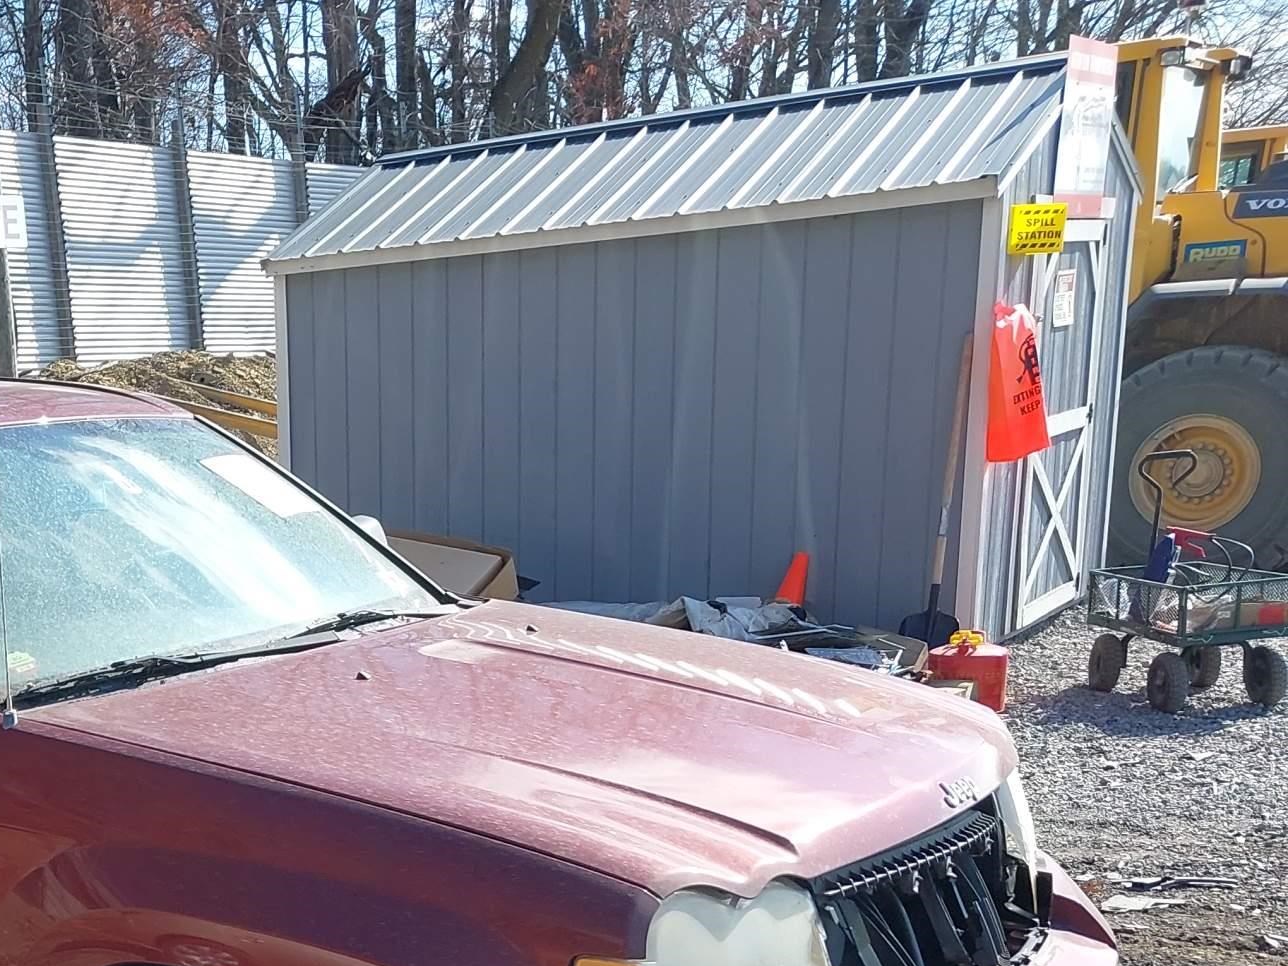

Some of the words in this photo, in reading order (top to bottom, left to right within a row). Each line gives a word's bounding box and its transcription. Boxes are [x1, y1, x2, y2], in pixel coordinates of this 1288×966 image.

[1245, 198, 1288, 210] VO
[1026, 217, 1056, 227] SPILL
[1016, 230, 1062, 241] STATION
[1020, 400, 1040, 416] KEEP
[938, 776, 977, 809] Jeep
